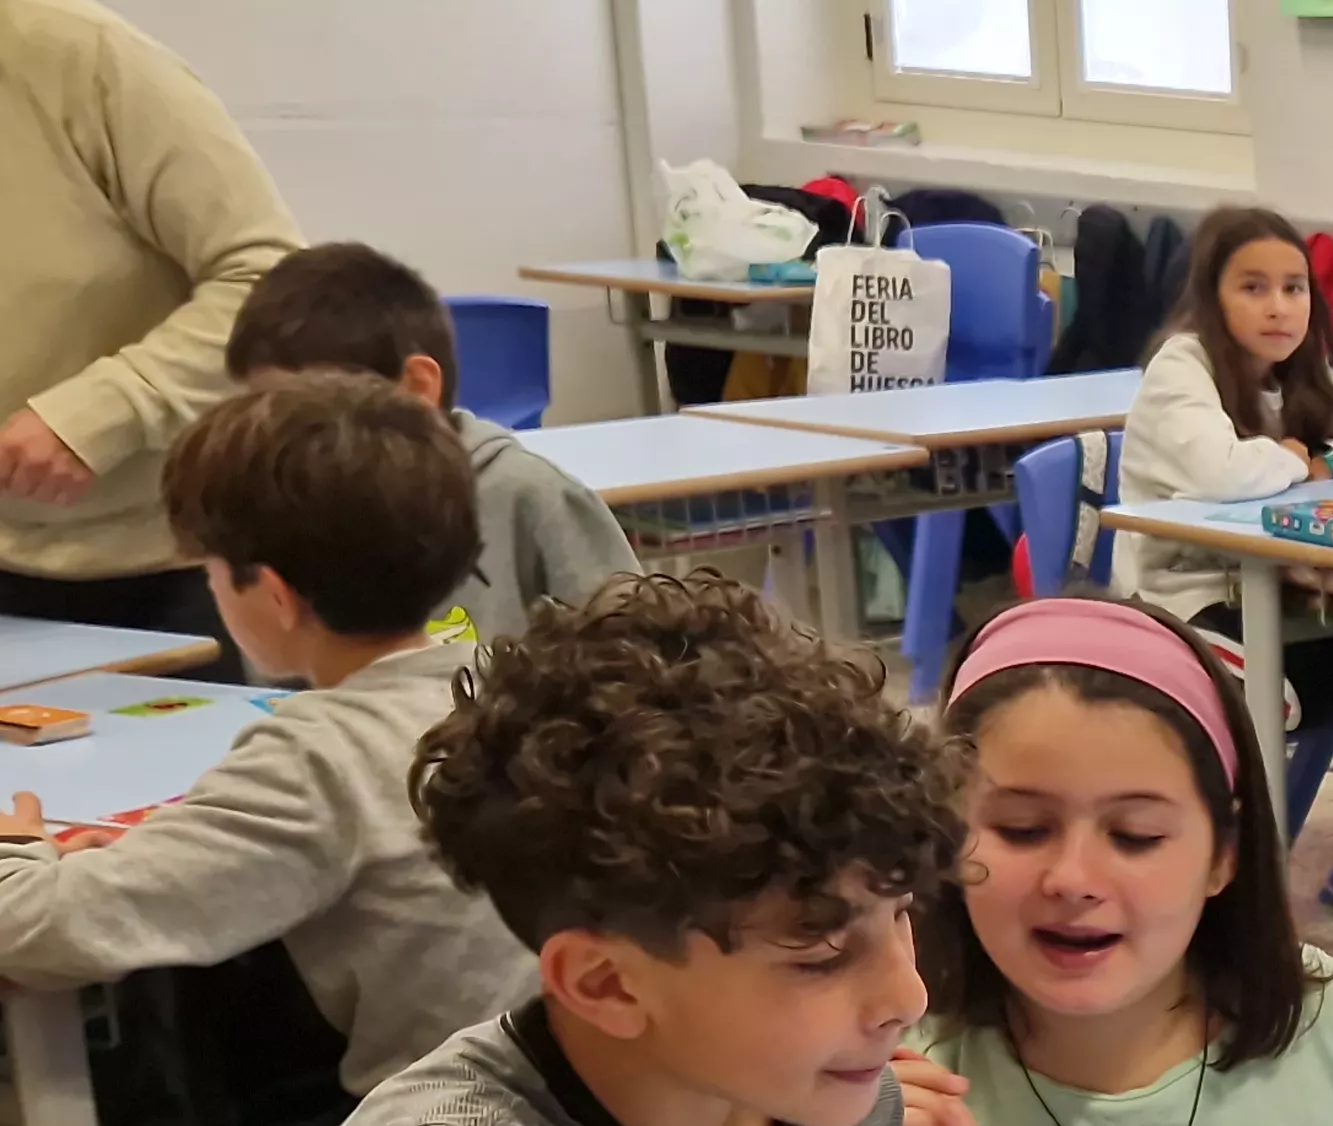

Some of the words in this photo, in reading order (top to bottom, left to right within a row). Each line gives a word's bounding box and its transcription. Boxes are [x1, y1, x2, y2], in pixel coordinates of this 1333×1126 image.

[852, 274, 914, 301] FERIA
[851, 300, 891, 325] DEL
[850, 324, 914, 351] LIBRO
[850, 351, 880, 375] DE
